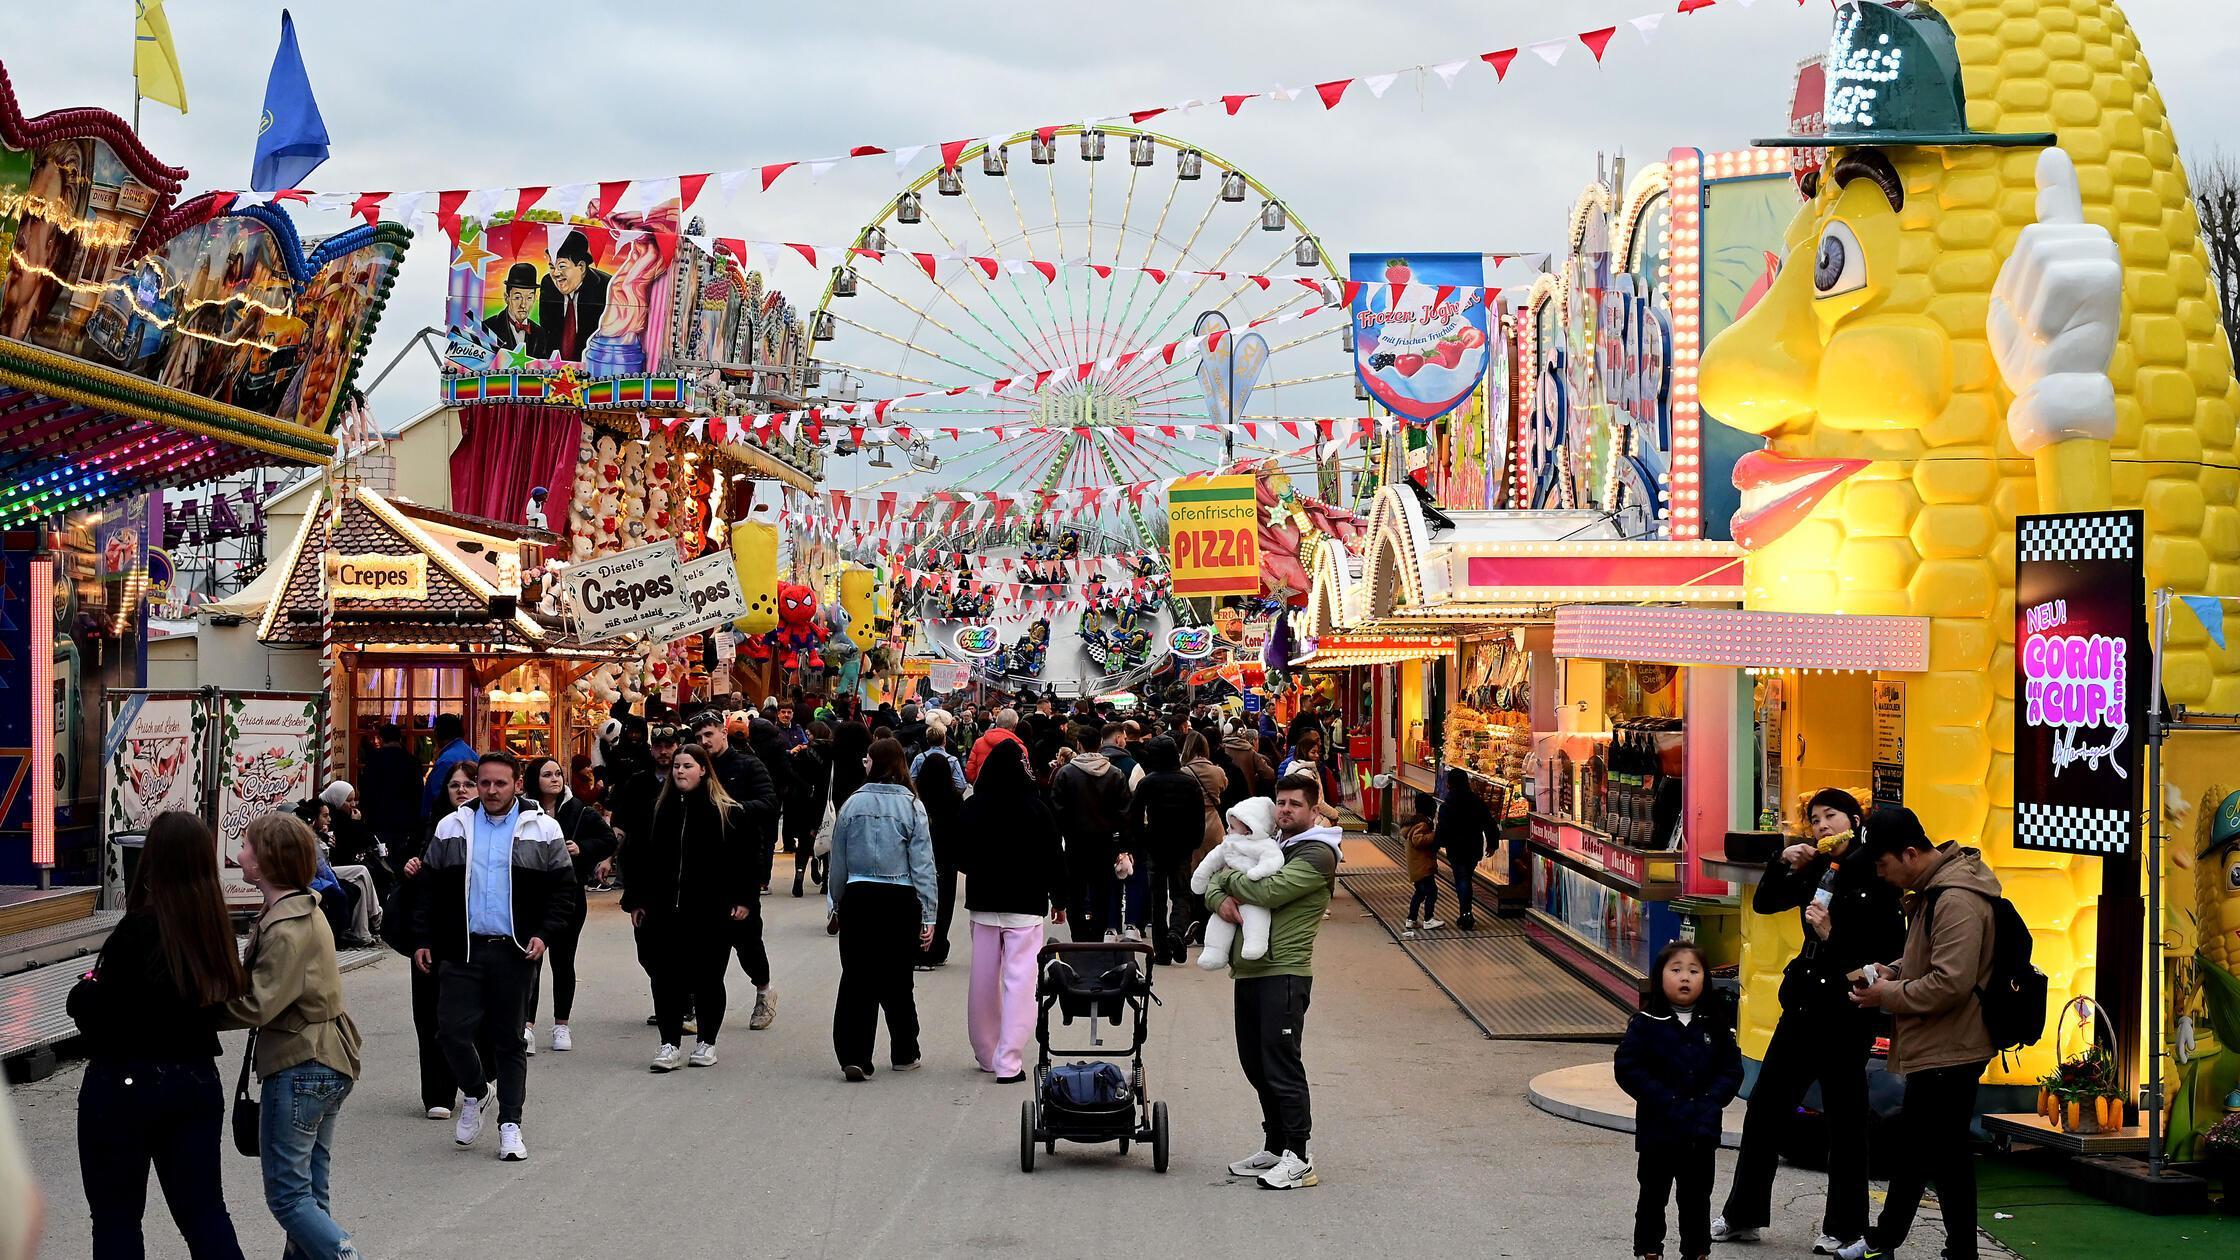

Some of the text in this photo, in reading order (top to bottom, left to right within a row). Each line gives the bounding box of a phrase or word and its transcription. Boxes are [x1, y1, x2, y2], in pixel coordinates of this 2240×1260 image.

[92, 192, 113, 203] DINER
[1357, 309, 1416, 329] Frozen
[445, 340, 487, 360] Movies
[1381, 334, 1394, 344] mit
[1394, 337, 1427, 347] frischen
[1171, 505, 1255, 521] ofenfrische
[1174, 527, 1255, 570] PIZZA
[340, 564, 408, 590] Crepes
[598, 558, 645, 579] Distel's
[683, 568, 705, 582] tel's
[581, 573, 674, 615] Crêpes
[690, 579, 731, 615] pes
[604, 607, 664, 630] süß und salzig
[671, 609, 723, 633] süß und salzig
[2026, 599, 2068, 635] NEU!
[961, 639, 995, 648] DOWN
[963, 629, 989, 640] KICK
[1176, 631, 1204, 641] KICK
[1174, 640, 1206, 650] DOWN
[2024, 634, 2114, 682] CORN
[2112, 641, 2124, 702] more
[2028, 698, 2041, 722] A
[2043, 681, 2107, 725] CUP
[135, 717, 154, 735] Frisch
[154, 721, 163, 733] und
[237, 712, 308, 728] Frisch und Lecker
